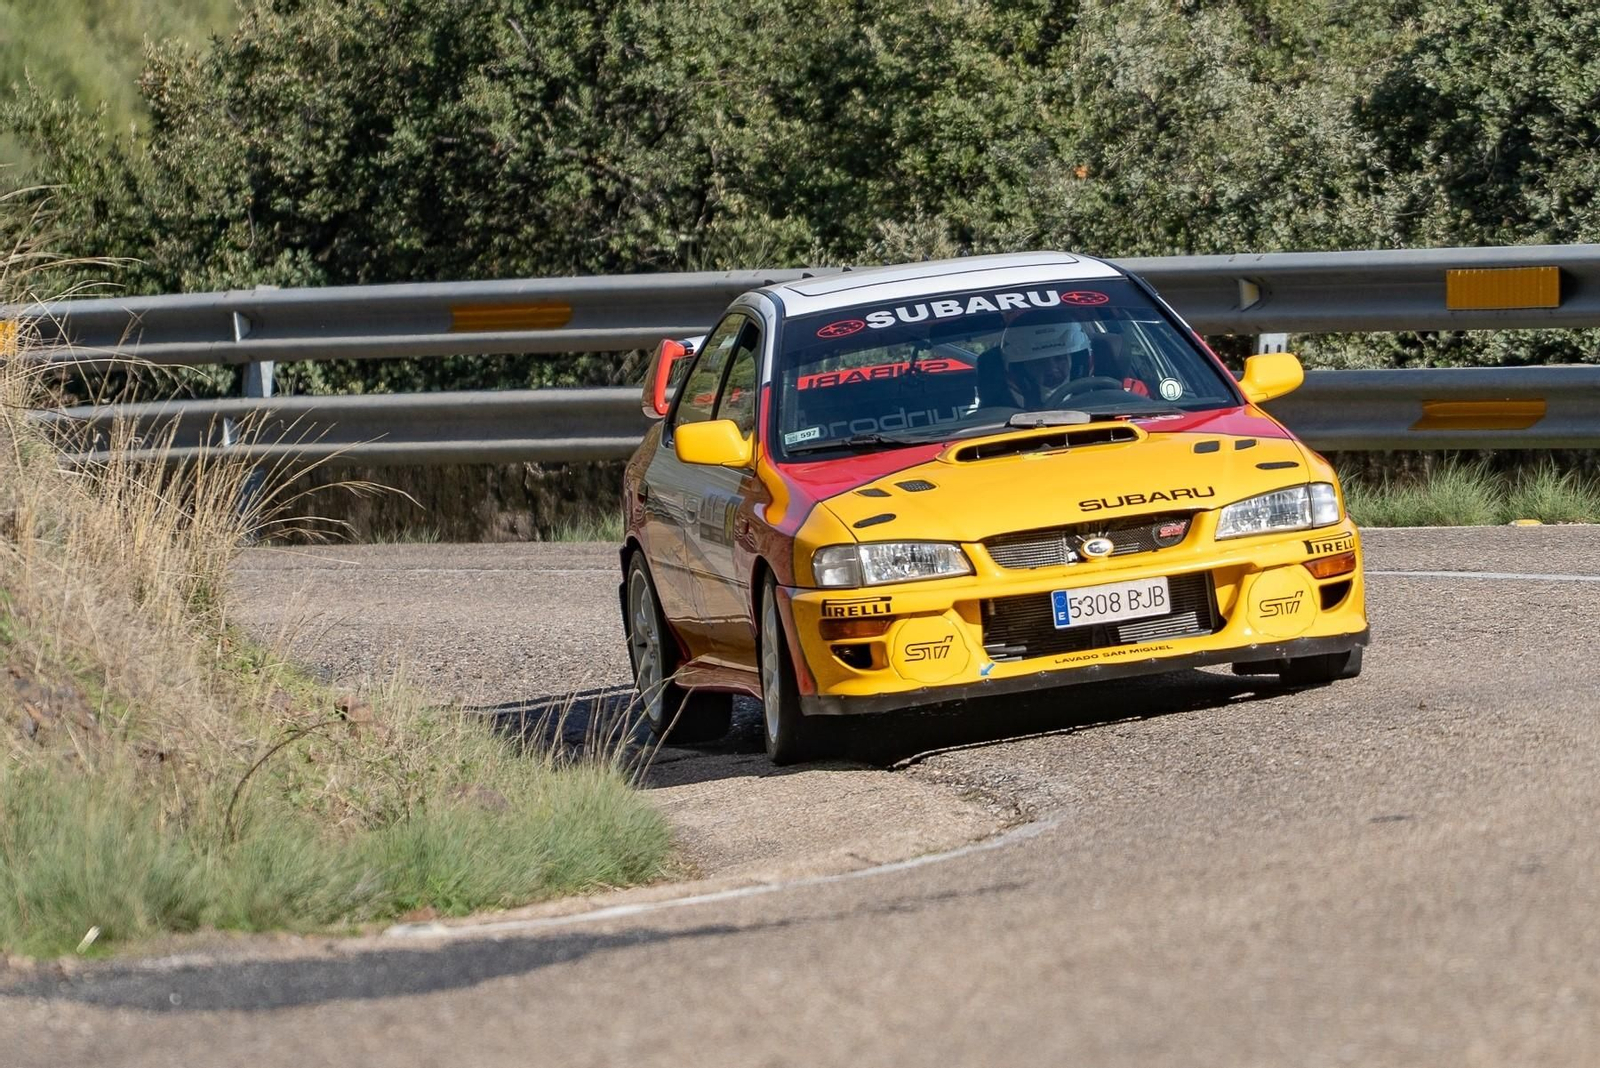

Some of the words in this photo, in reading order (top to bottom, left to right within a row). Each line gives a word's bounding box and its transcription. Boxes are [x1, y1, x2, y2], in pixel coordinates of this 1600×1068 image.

[865, 290, 1061, 329] SUBARU
[800, 430, 816, 439] 597
[1078, 486, 1215, 512] SUBARU
[821, 596, 892, 617] PIRELLI
[1069, 592, 1121, 618] 5308
[1128, 585, 1165, 610] BJB
[1058, 612, 1066, 620] E
[1054, 653, 1099, 664] LAVADO
[1103, 650, 1126, 659] SAN
[1129, 644, 1174, 654] MIGUEL
